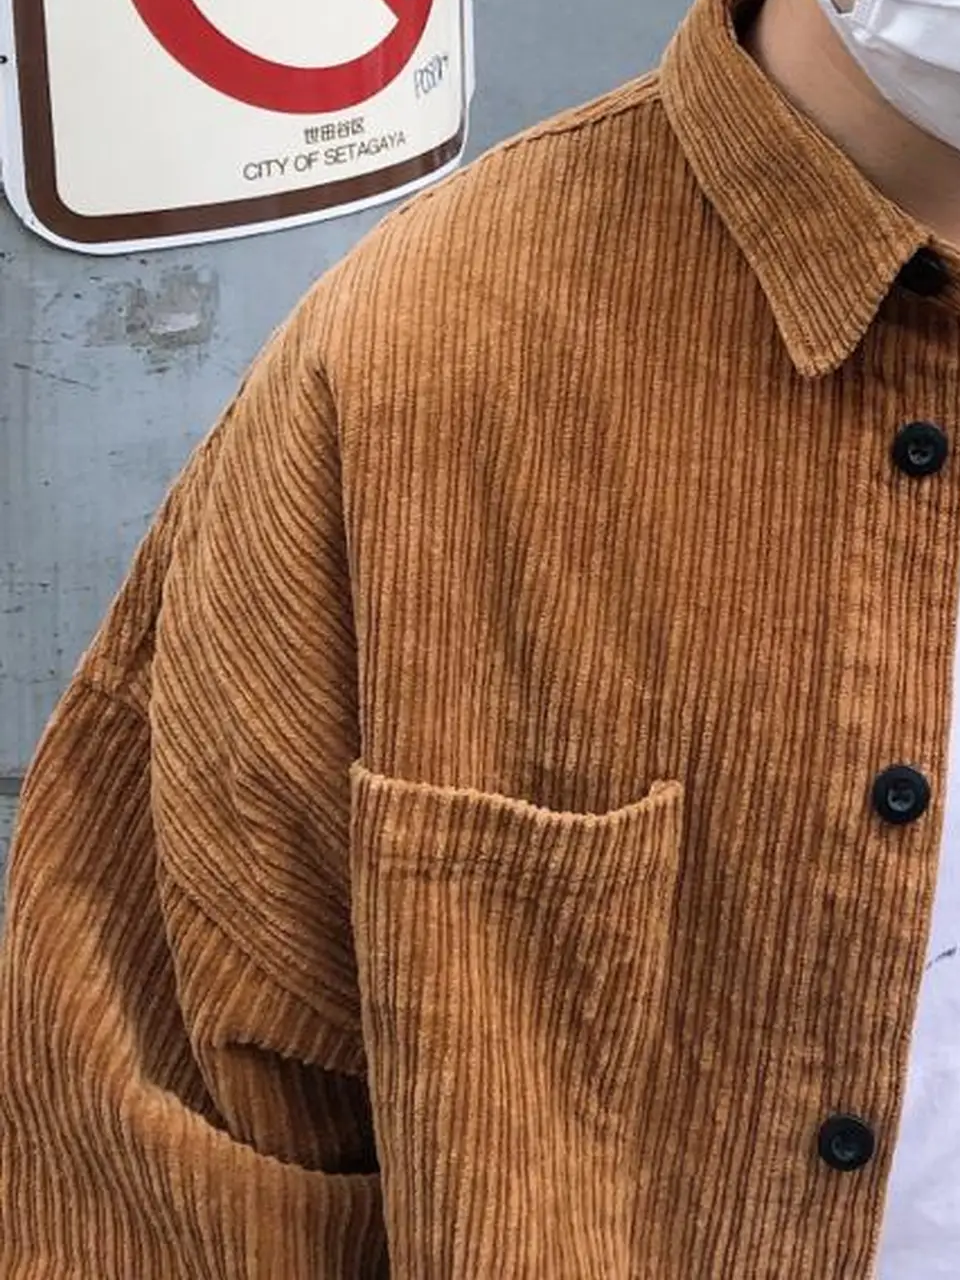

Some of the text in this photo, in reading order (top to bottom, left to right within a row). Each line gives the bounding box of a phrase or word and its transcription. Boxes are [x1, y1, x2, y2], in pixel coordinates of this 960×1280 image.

[303, 117, 366, 145] 世田谷区
[242, 130, 407, 181] CITY OF SETAGAYA
